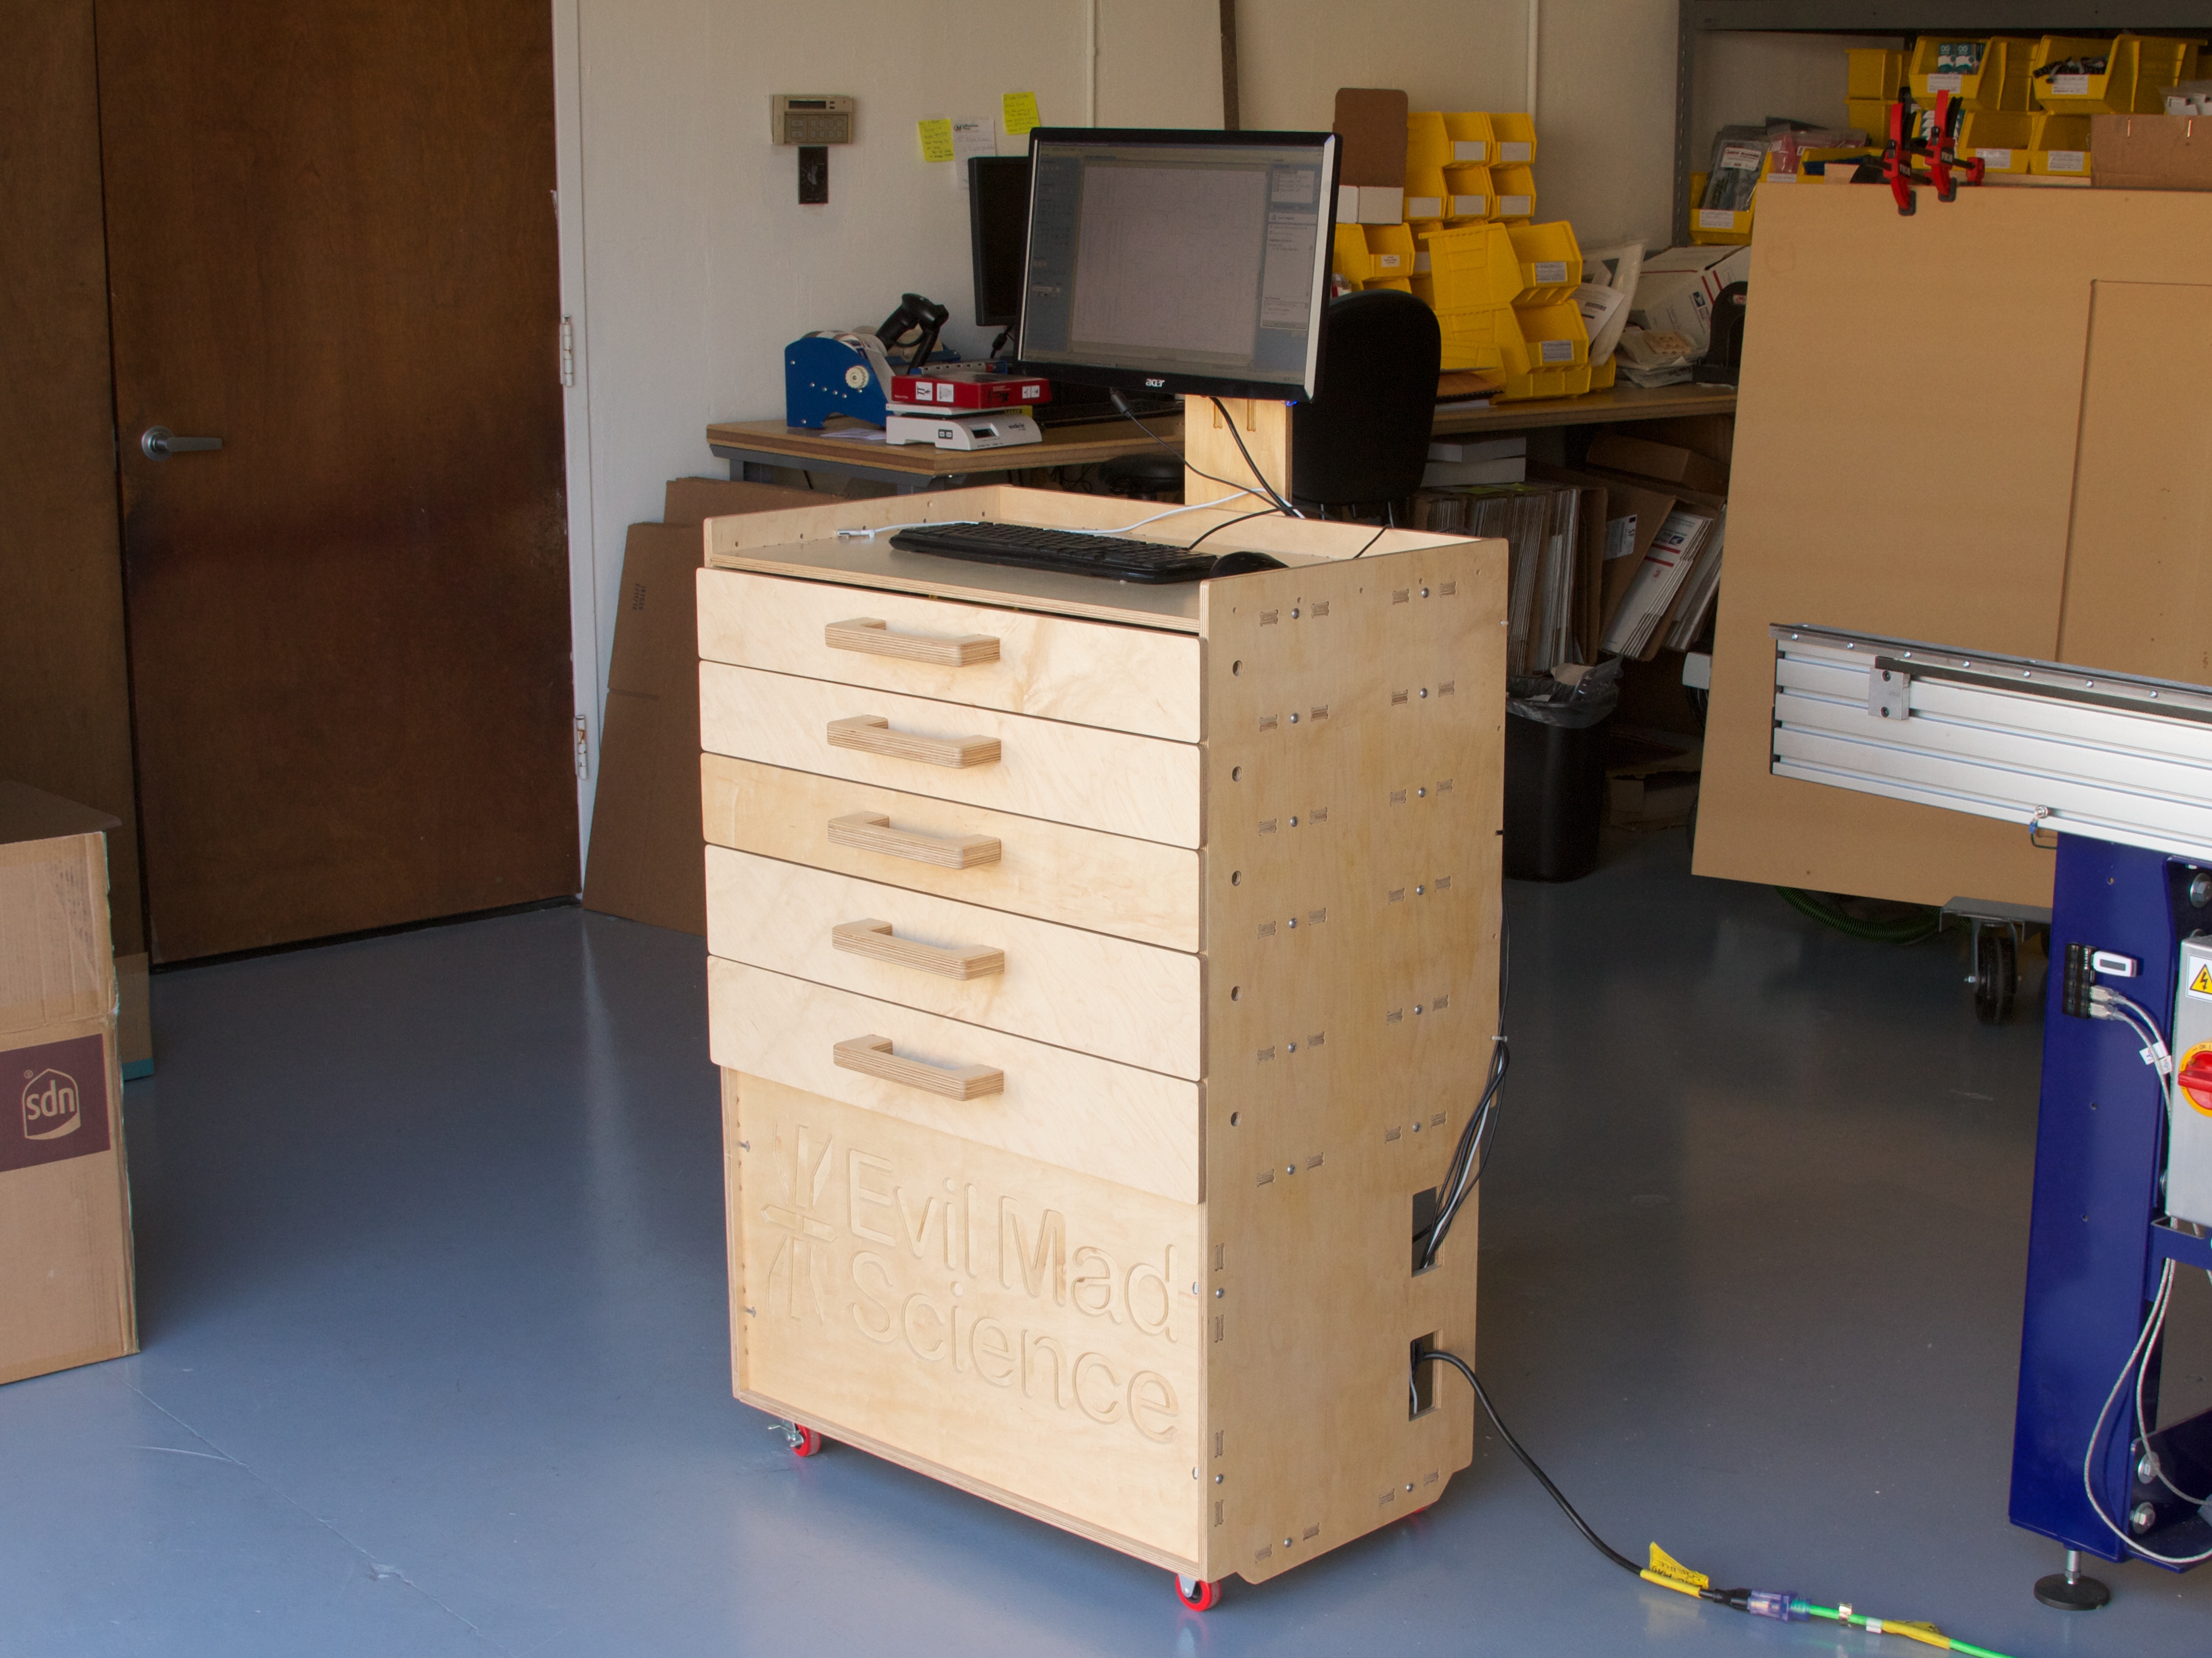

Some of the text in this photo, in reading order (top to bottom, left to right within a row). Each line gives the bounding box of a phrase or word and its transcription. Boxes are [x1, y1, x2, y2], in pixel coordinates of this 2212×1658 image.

[1145, 378, 1165, 388] acer
[847, 1148, 1179, 1343] Evil Mad
[848, 1250, 1180, 1445] Science
